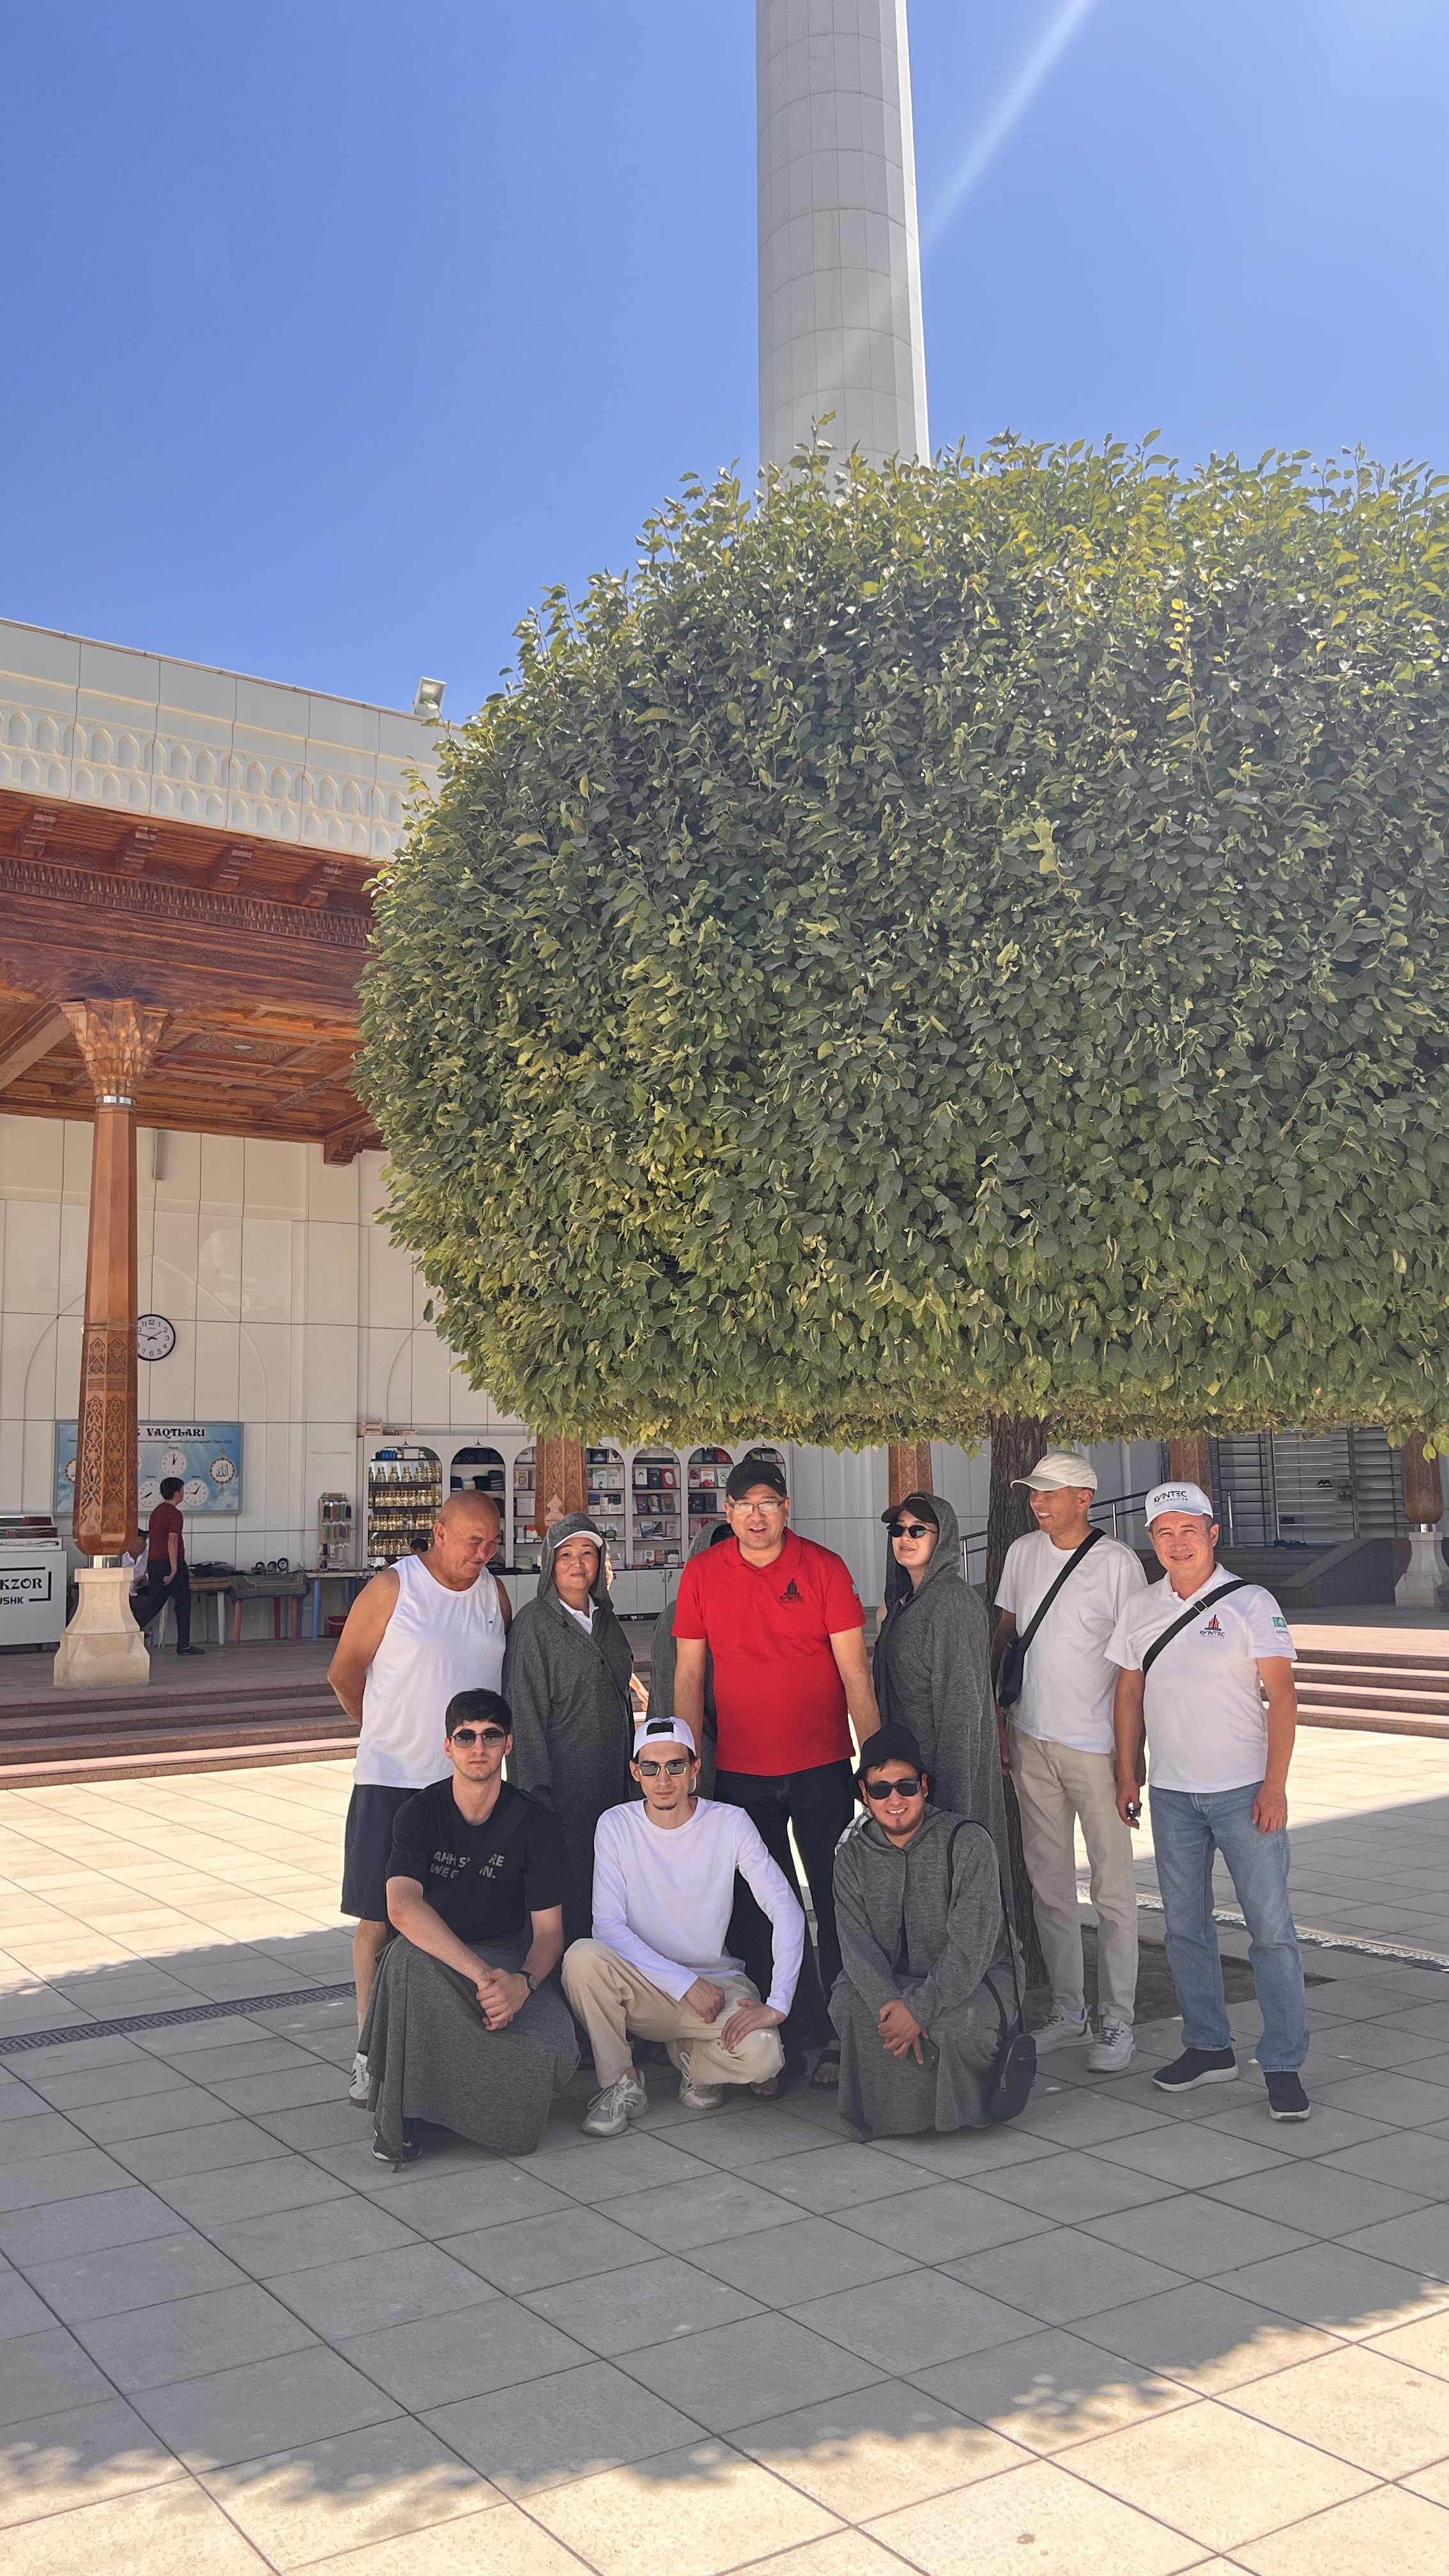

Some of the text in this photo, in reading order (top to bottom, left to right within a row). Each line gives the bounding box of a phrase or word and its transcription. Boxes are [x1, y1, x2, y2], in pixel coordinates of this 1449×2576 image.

[146, 1428, 206, 1439] VAQTLARI
[1154, 1491, 1187, 1503] KVINTEC
[433, 1851, 457, 1866] AHH
[488, 1853, 505, 1867] RE
[429, 1863, 450, 1878] WE
[479, 1865, 496, 1880] IN.
